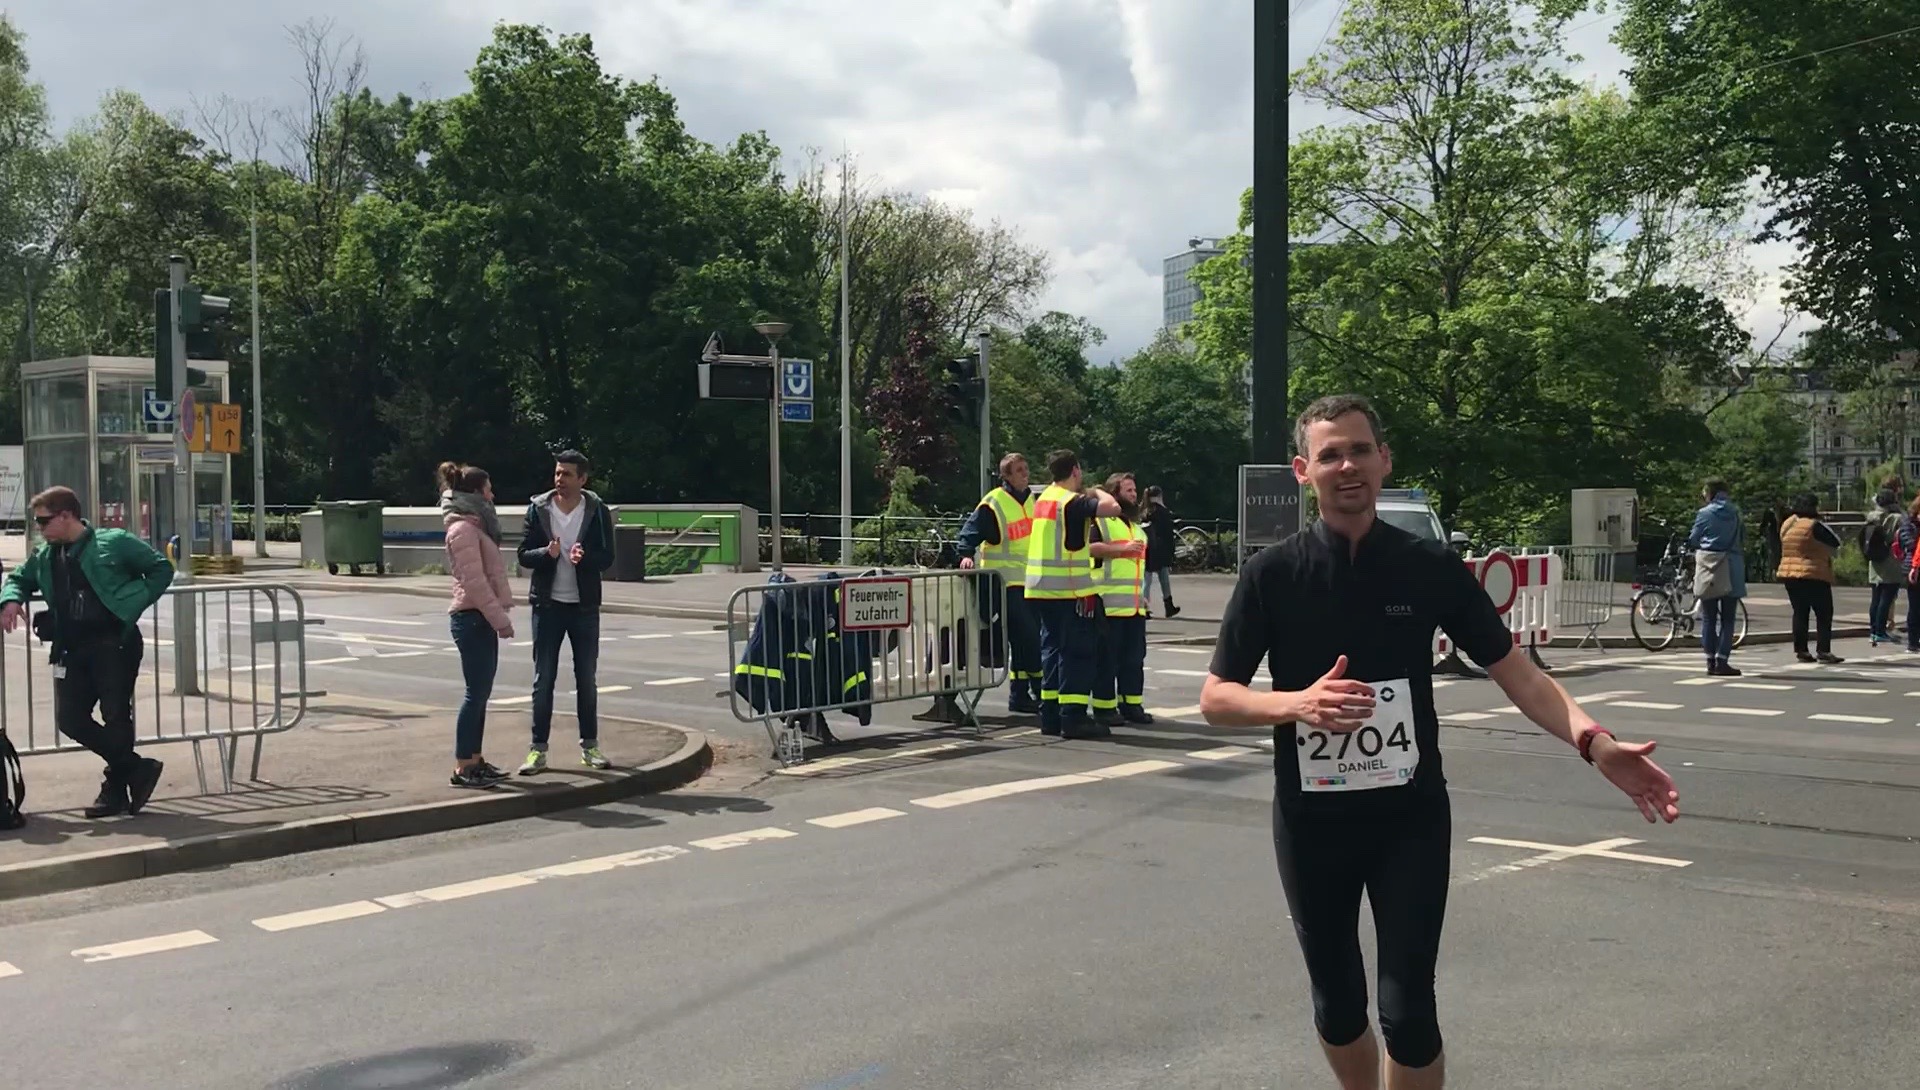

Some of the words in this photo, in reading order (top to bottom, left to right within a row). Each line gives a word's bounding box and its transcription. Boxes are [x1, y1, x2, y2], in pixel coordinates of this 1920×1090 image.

[1246, 494, 1299, 507] OTELLO
[849, 587, 904, 603] Feuerwehr-
[855, 606, 899, 622] zufahrt
[1308, 721, 1412, 761] 2704
[1337, 759, 1389, 773] DANIEL
